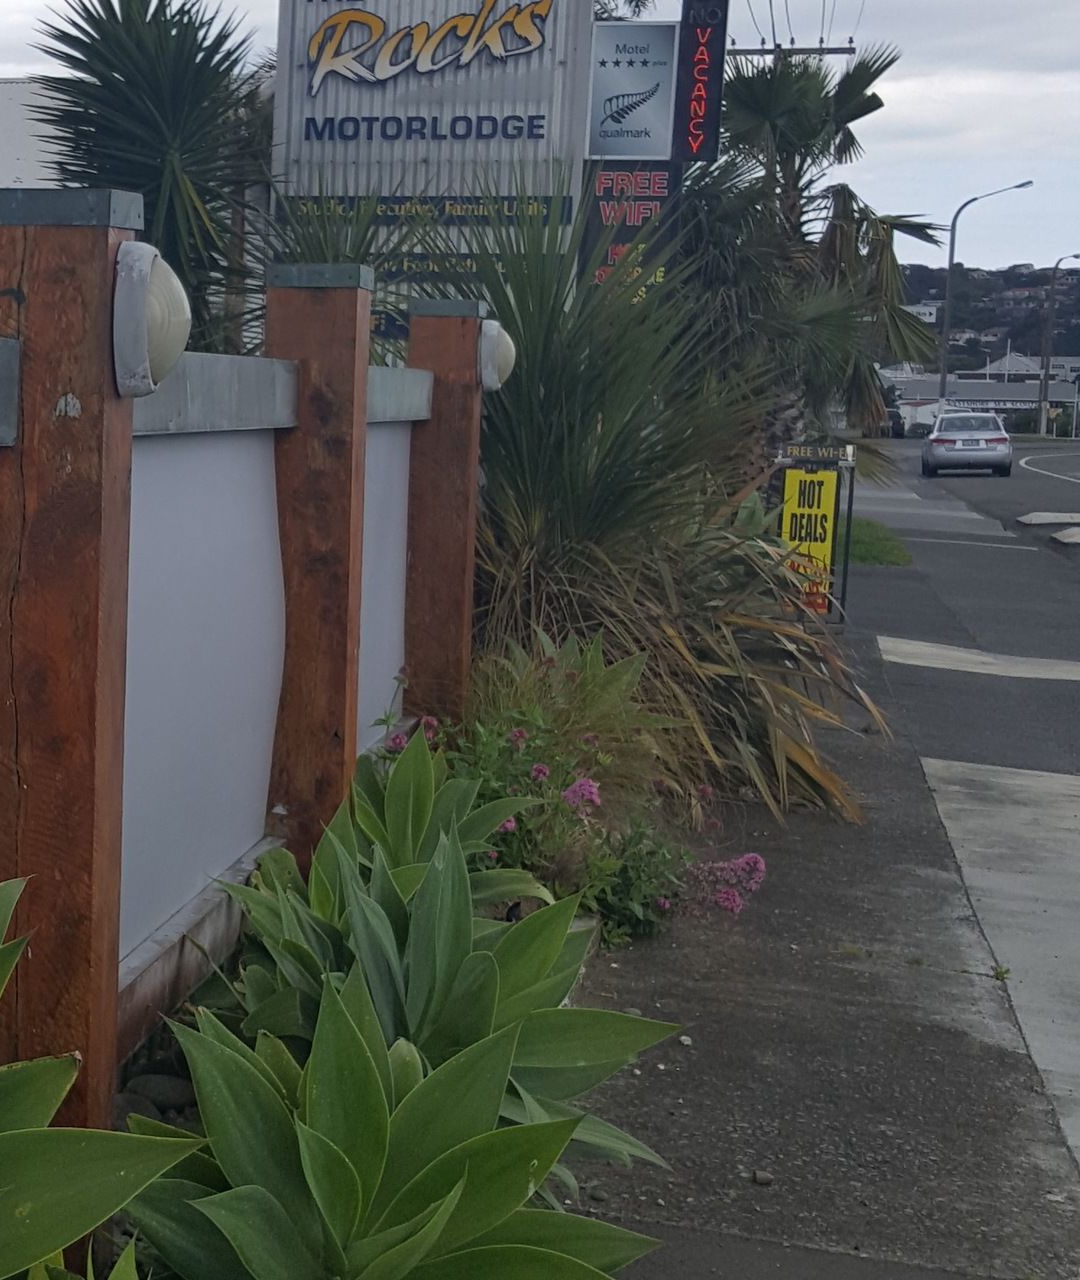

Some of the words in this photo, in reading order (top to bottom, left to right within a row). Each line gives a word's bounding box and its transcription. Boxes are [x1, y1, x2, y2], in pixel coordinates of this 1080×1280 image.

[689, 7, 721, 24] NO
[615, 43, 650, 55] Motel
[688, 26, 712, 154] VACANCY
[304, 115, 546, 141] MOTORLODGE
[599, 127, 651, 140] qualmark
[596, 171, 669, 197] FREE
[599, 201, 660, 226] WIFI
[787, 446, 813, 457] FREE
[818, 447, 851, 459] WI-F
[797, 480, 824, 509] HOT
[789, 513, 828, 543] DEALS
